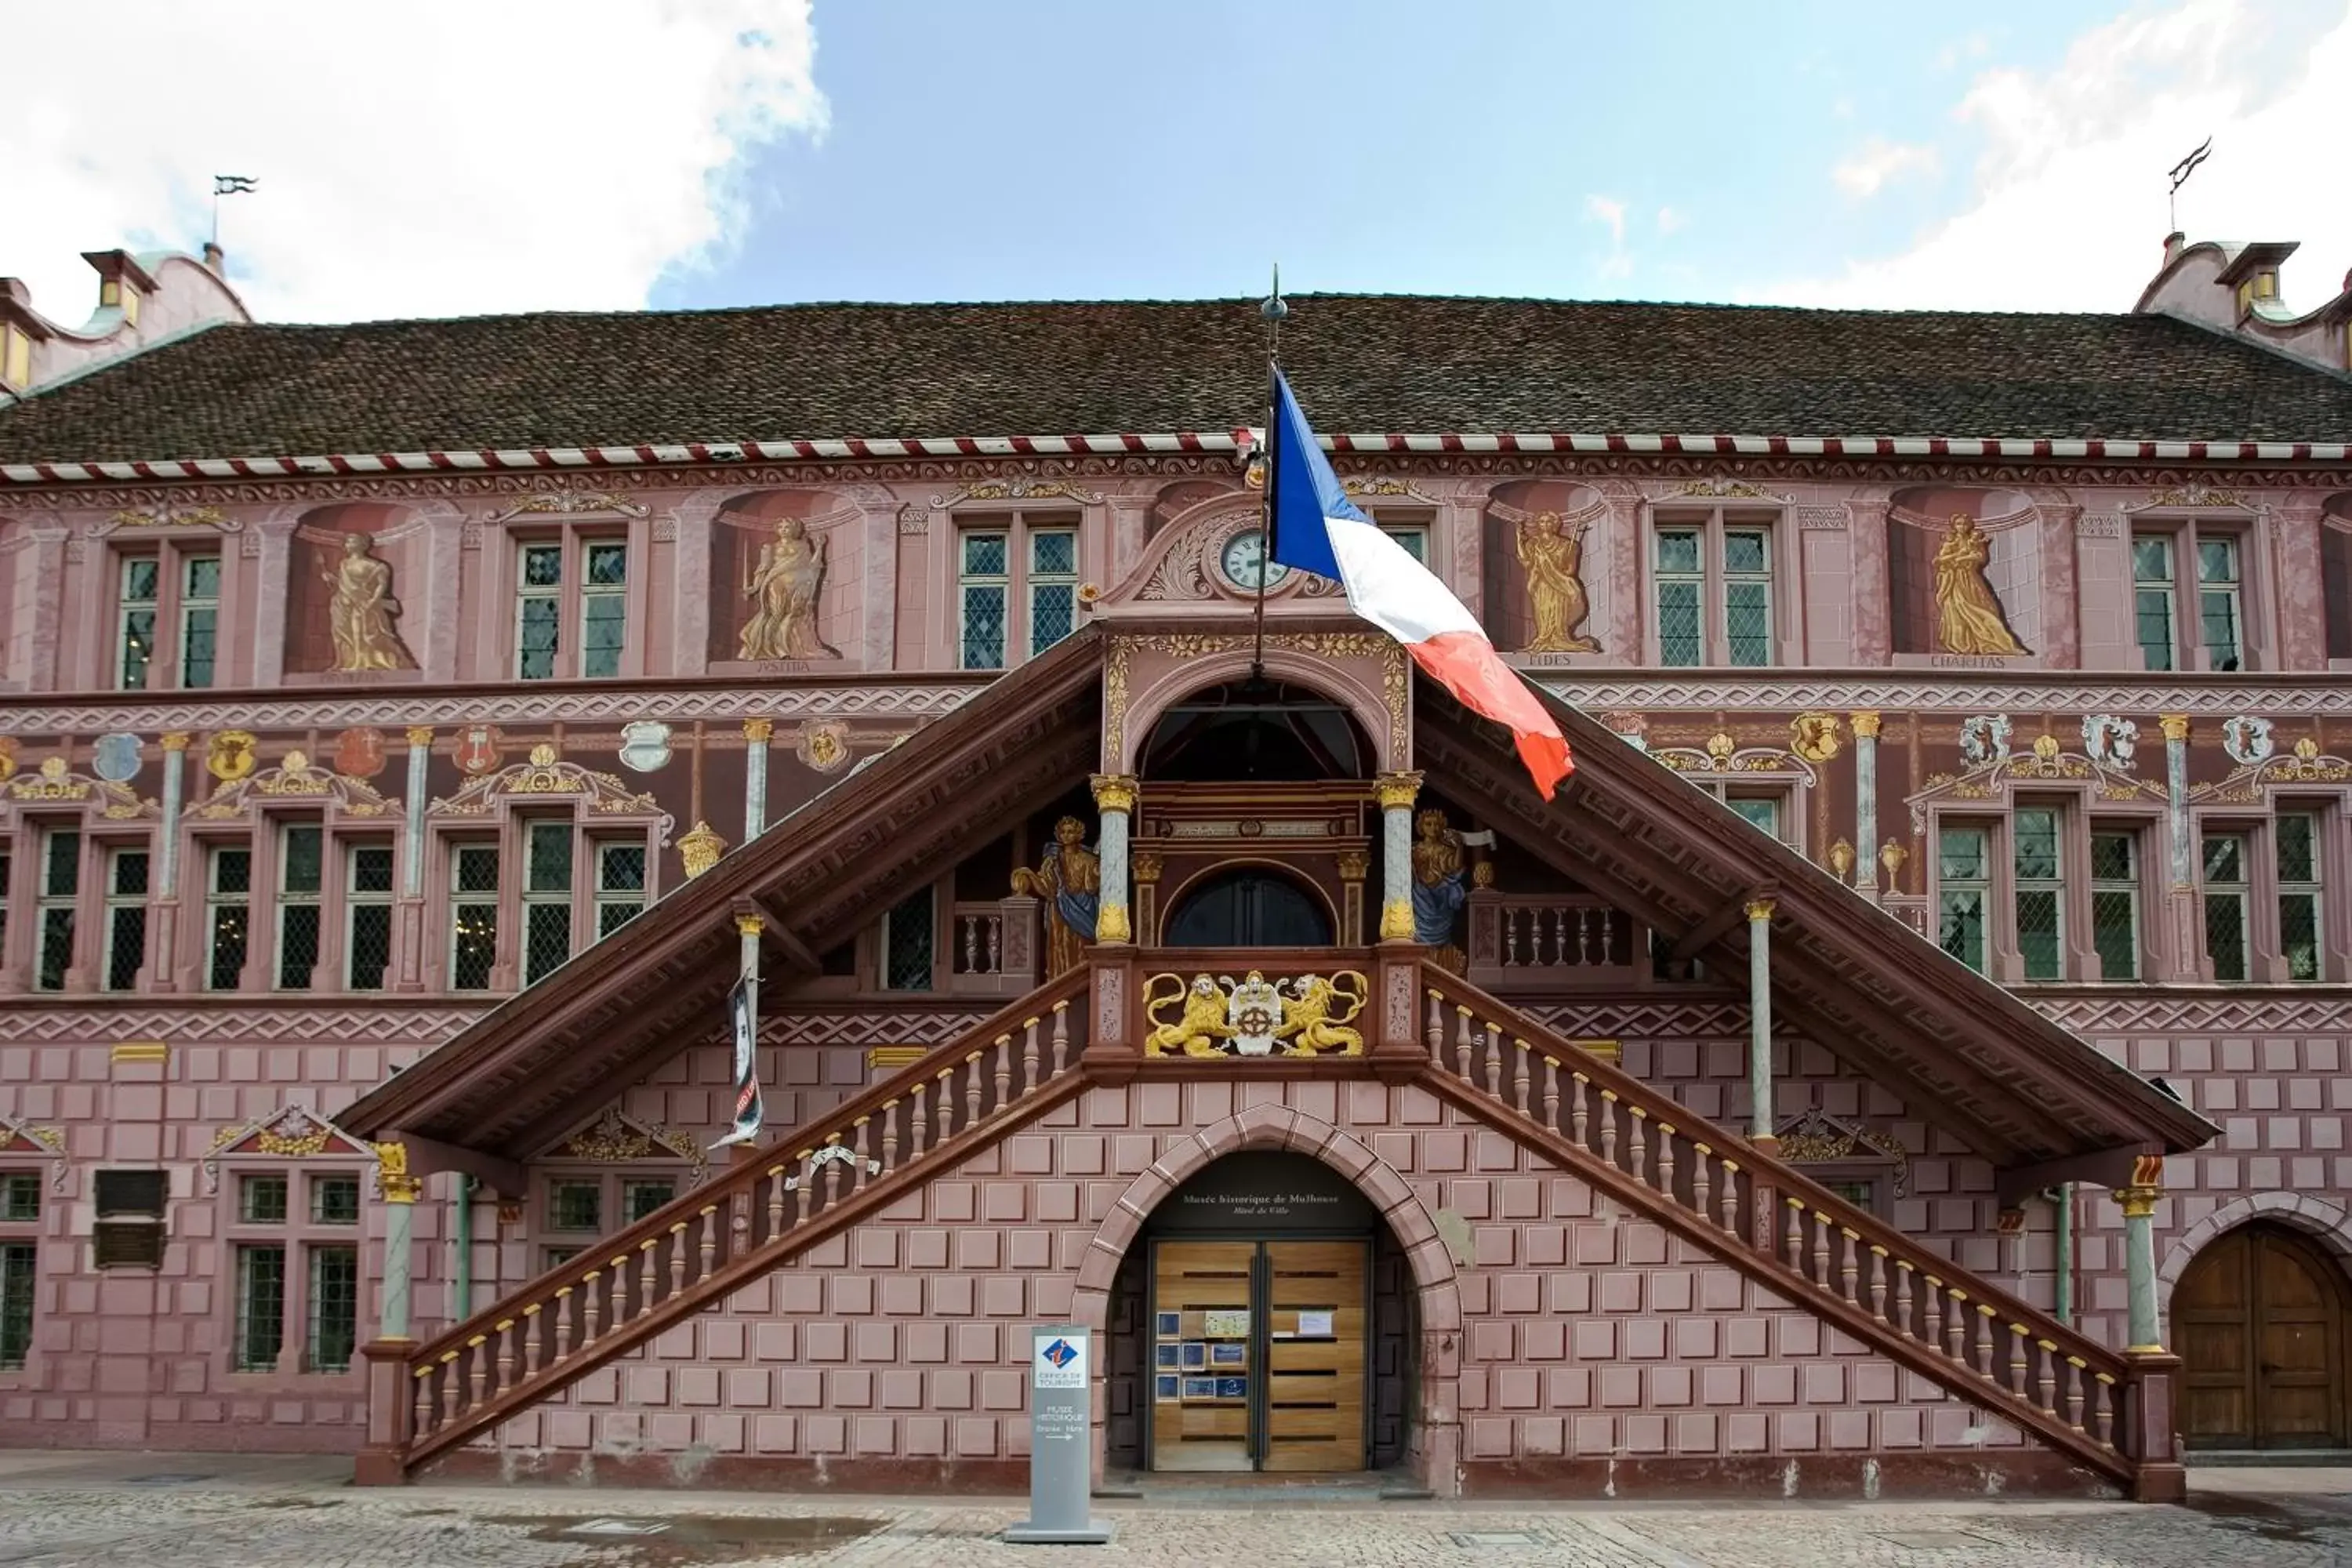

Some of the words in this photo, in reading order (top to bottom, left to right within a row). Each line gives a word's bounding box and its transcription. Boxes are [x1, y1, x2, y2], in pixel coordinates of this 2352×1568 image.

[1183, 1194, 1215, 1203] Musée
[1219, 1194, 1271, 1206] historique
[1273, 1194, 1287, 1203] de
[1290, 1194, 1340, 1203] Mulhouse
